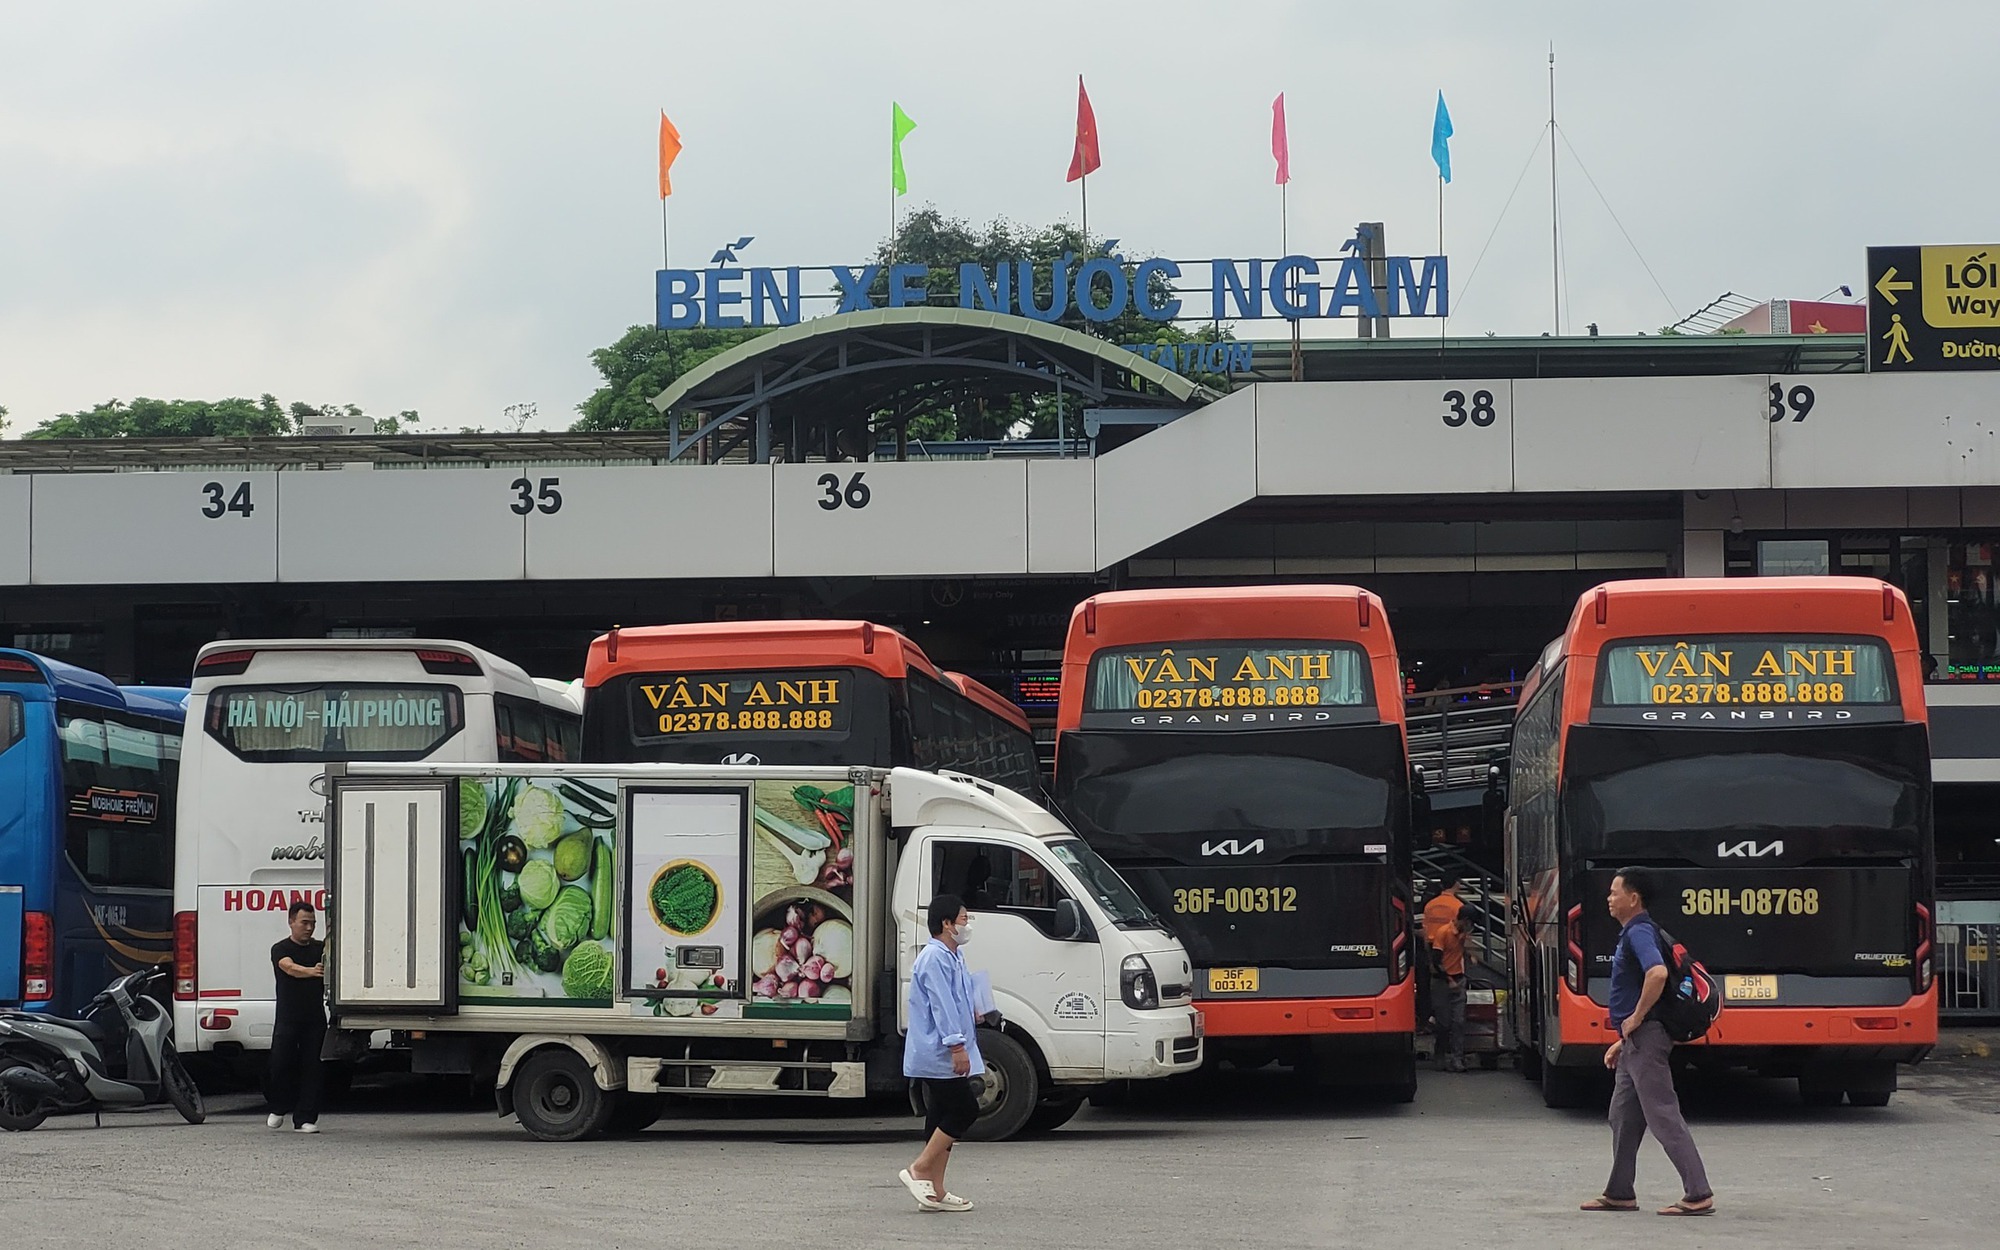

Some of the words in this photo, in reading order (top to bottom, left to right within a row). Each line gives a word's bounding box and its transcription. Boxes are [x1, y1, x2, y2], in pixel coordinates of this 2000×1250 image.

[1945, 252, 1997, 289] LỐI
[656, 237, 801, 330] BẾN
[830, 262, 929, 314] XE
[959, 239, 1183, 323] NƯỚC
[1946, 295, 2000, 319] Way
[1120, 341, 1254, 374] TATION
[1942, 339, 2000, 360] Đườn
[1441, 388, 1494, 428] 38
[201, 481, 254, 518] 34
[510, 477, 563, 516] 35
[816, 472, 872, 512] 36
[1124, 648, 1219, 684] VÂN
[1231, 653, 1332, 682] ANH
[1635, 642, 1735, 677] VÂN
[1752, 649, 1857, 677] ANH
[639, 676, 731, 710] VÂN
[743, 679, 841, 706] ANH
[1137, 686, 1320, 709] 02378.888.888
[1652, 681, 1845, 704] 02378.888.888
[228, 694, 258, 728] HÀ
[264, 695, 305, 733] NỘI
[322, 690, 359, 728] HẢI
[363, 693, 445, 727] PHÒNG
[658, 709, 834, 733] 02378.888.888
[1130, 712, 1331, 725] GRANBIRD
[1642, 711, 1852, 721] GRANBIRD
[298, 811, 325, 823] TH
[1202, 839, 1264, 856] KIA
[1717, 840, 1783, 858] KIA
[1173, 887, 1297, 914] 36F-00312
[1681, 888, 1819, 915] 36H-08768
[1214, 980, 1253, 991] 003.12
[1223, 969, 1244, 979] 36F
[1739, 976, 1763, 987] 36H
[1732, 987, 1772, 999] 087.68
